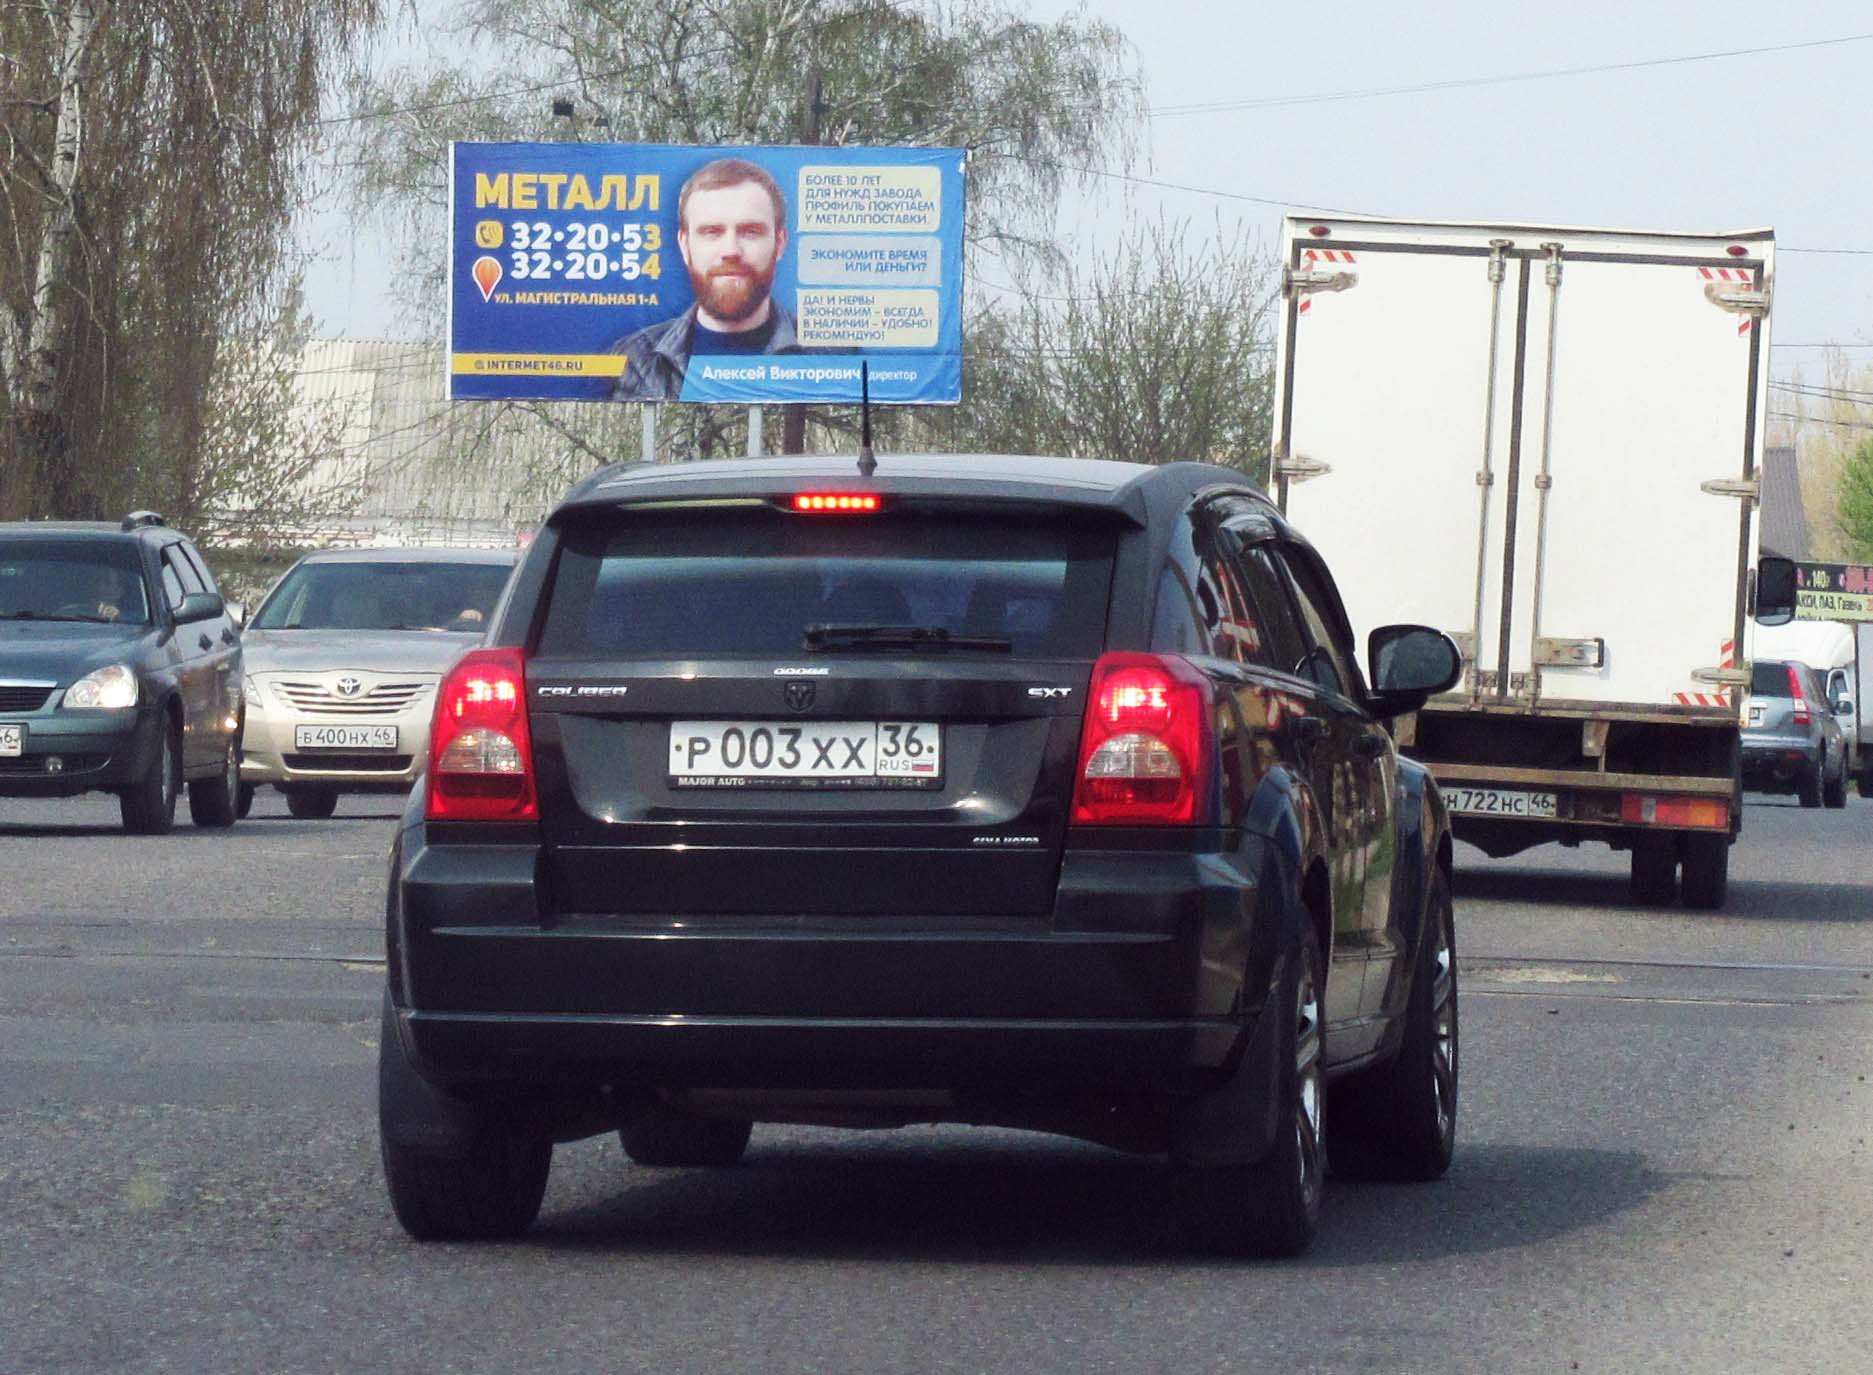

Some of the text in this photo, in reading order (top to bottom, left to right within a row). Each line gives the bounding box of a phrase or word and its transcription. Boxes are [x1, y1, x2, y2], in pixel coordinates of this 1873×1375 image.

[805, 175, 882, 186] БОЛЕЕ 10 ЛЕТ
[475, 173, 660, 211] МЕТАЛЛ
[805, 188, 922, 201] ДЛЯ НУЖД ЗАВОДА
[805, 201, 935, 212] ПРОФИЛЬ ПОКУПАЕМ
[805, 214, 928, 225] У МЕТАЛЛПОСТАВКИ
[811, 250, 928, 261] ЭКОНОМИТЕ ВРЕМЯ
[844, 262, 928, 274] ИЛИ ДЕНЬГИ?
[515, 292, 636, 305] МАГИСТРАЛЬНАЯ
[638, 293, 659, 305] 1-А
[803, 295, 876, 306] ДА! И НЕРВЫ
[803, 307, 872, 317] ЭКОНОМИМ
[884, 307, 924, 318] ВСЕГДА
[803, 319, 810, 329] В
[812, 319, 870, 329] НАЛИЧИИ
[881, 319, 932, 330] УДОБНО!
[803, 331, 885, 342] РЕКОМЕНДУЮ!
[702, 366, 766, 381] Алексей
[769, 367, 862, 383] Викторович
[1027, 688, 1073, 699] SXT
[374, 728, 391, 742] 46
[882, 724, 924, 758] 36
[879, 759, 910, 771] RUS
[678, 776, 716, 786] MAJOR
[717, 777, 746, 786] AUTO
[1532, 793, 1551, 809] 46
